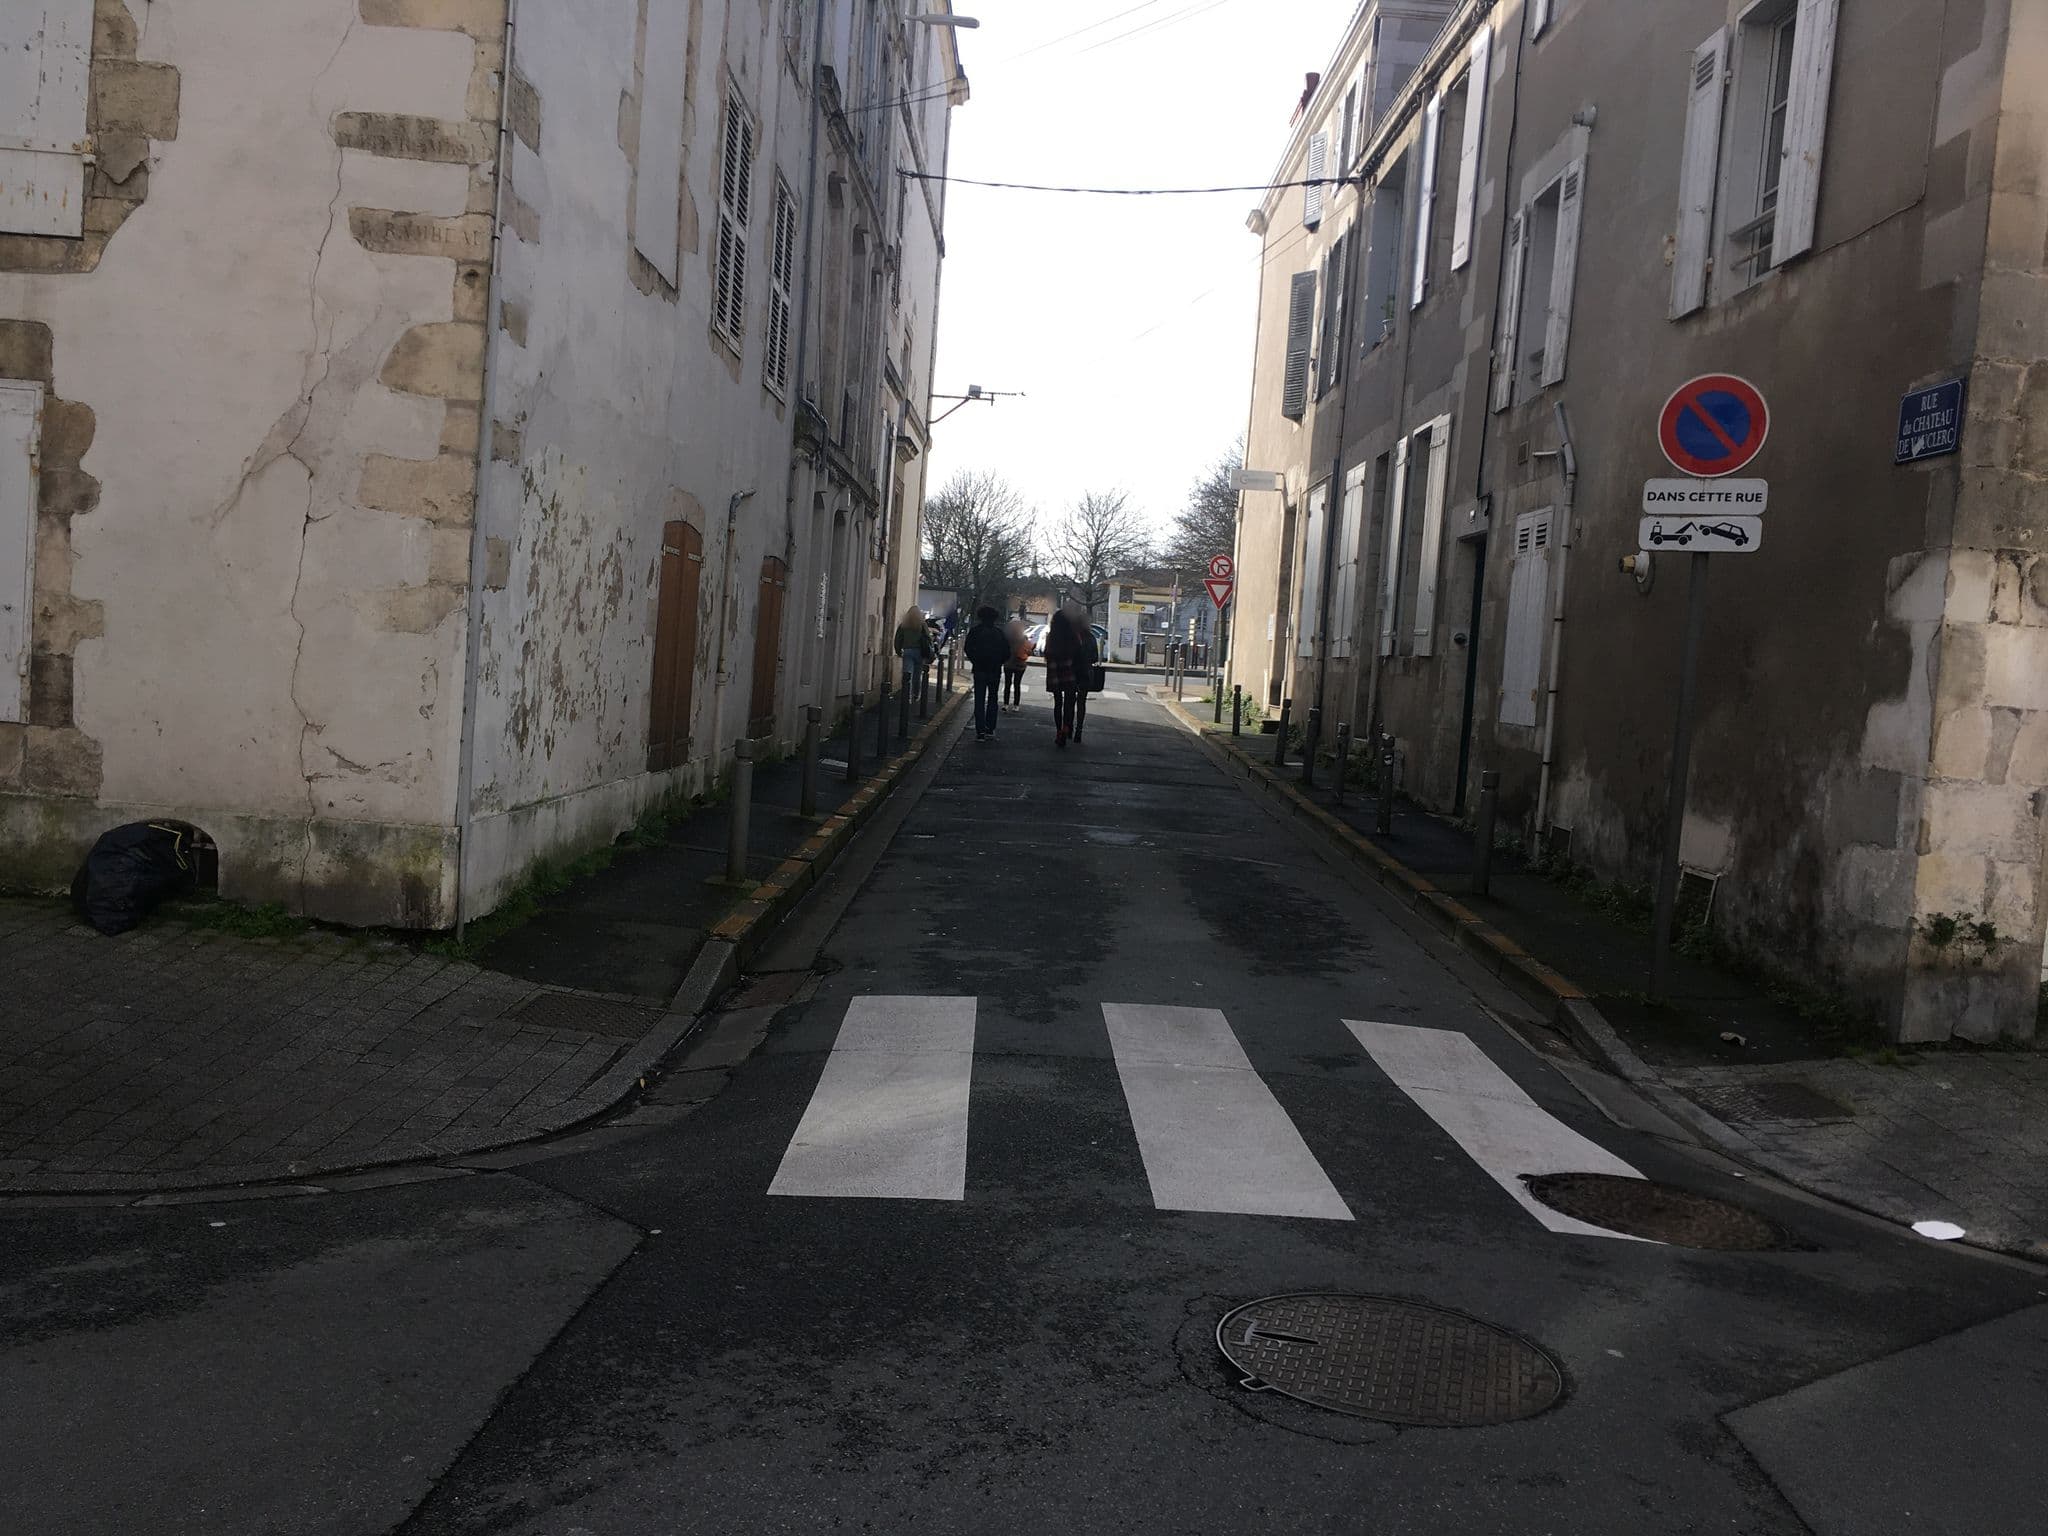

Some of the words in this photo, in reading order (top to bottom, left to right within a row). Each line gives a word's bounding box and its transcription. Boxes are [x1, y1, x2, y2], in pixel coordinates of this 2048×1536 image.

[1921, 392, 1939, 412] RUE
[1913, 408, 1955, 433] CHATEAU
[1898, 438, 1910, 455] DE
[1911, 427, 1954, 453] VUCLERC
[1647, 491, 1685, 502] DANS
[1688, 492, 1732, 502] CETTE
[1736, 492, 1763, 503] RUE
